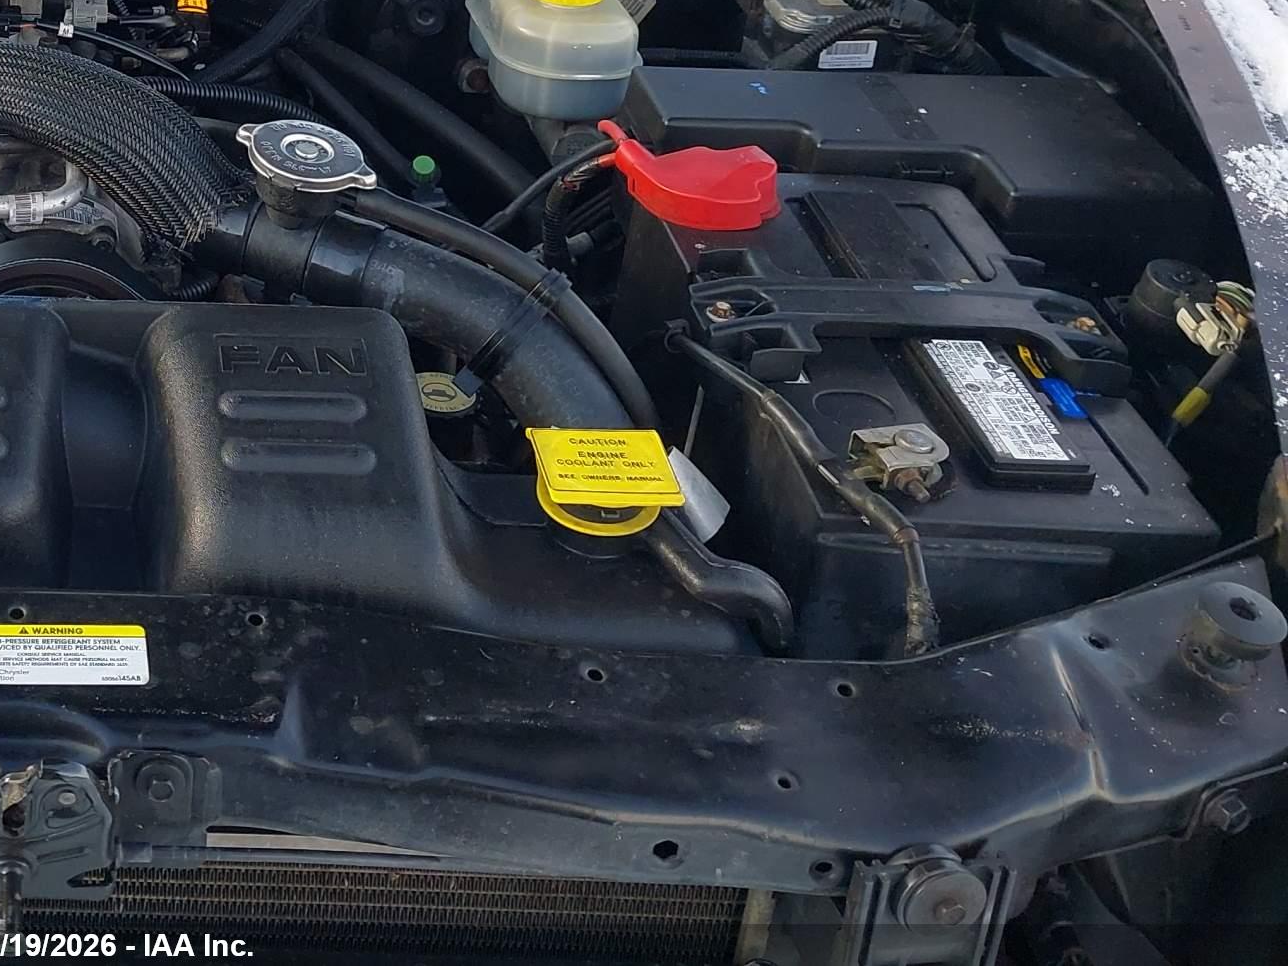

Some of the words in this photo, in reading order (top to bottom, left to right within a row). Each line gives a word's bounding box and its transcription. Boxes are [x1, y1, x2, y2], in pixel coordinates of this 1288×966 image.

[220, 340, 367, 376] FAN
[1006, 370, 1061, 435] DANGER/POISON
[568, 437, 627, 446] CAUTION
[577, 451, 628, 459] ENGINE
[556, 458, 615, 467] COOLANT
[622, 460, 655, 468] ONLY
[32, 627, 83, 635] WARNING
